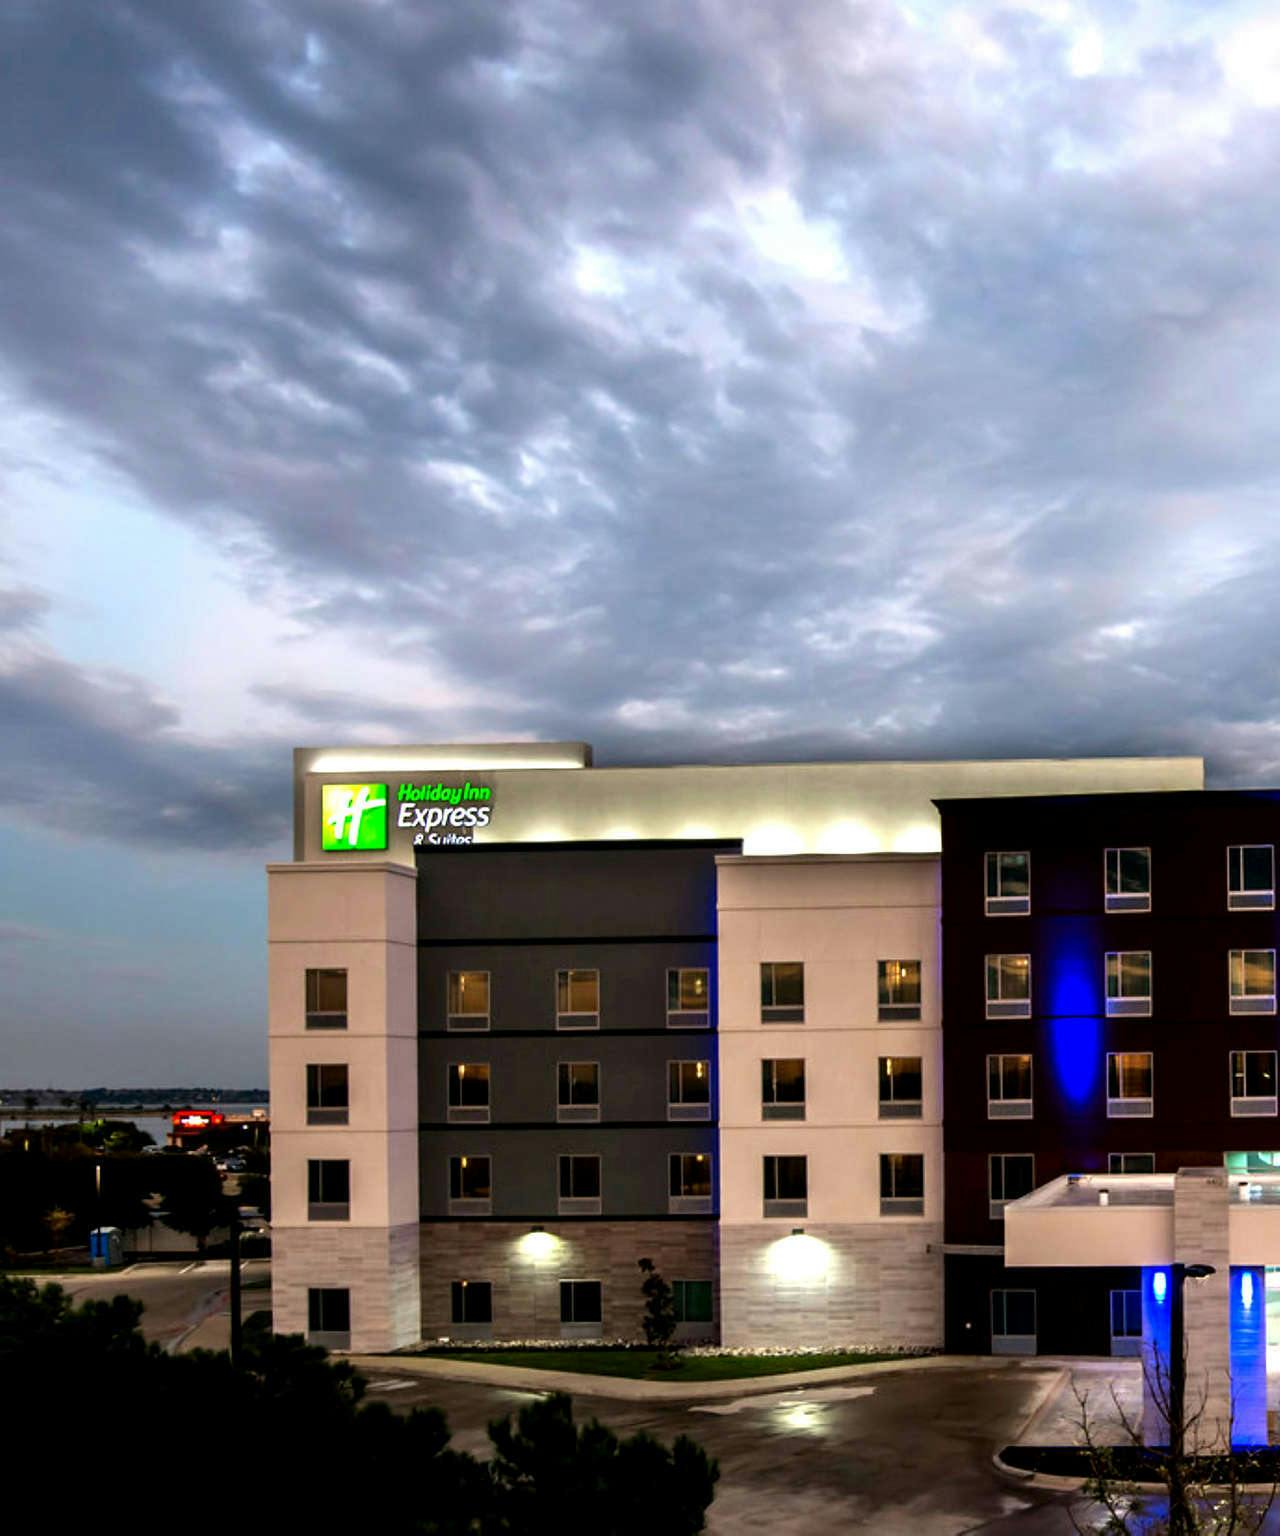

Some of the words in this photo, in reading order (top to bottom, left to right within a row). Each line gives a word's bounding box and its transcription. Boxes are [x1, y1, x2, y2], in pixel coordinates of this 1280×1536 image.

[398, 783, 463, 805] Holiday
[463, 782, 491, 801] Inn
[397, 802, 490, 833] Express
